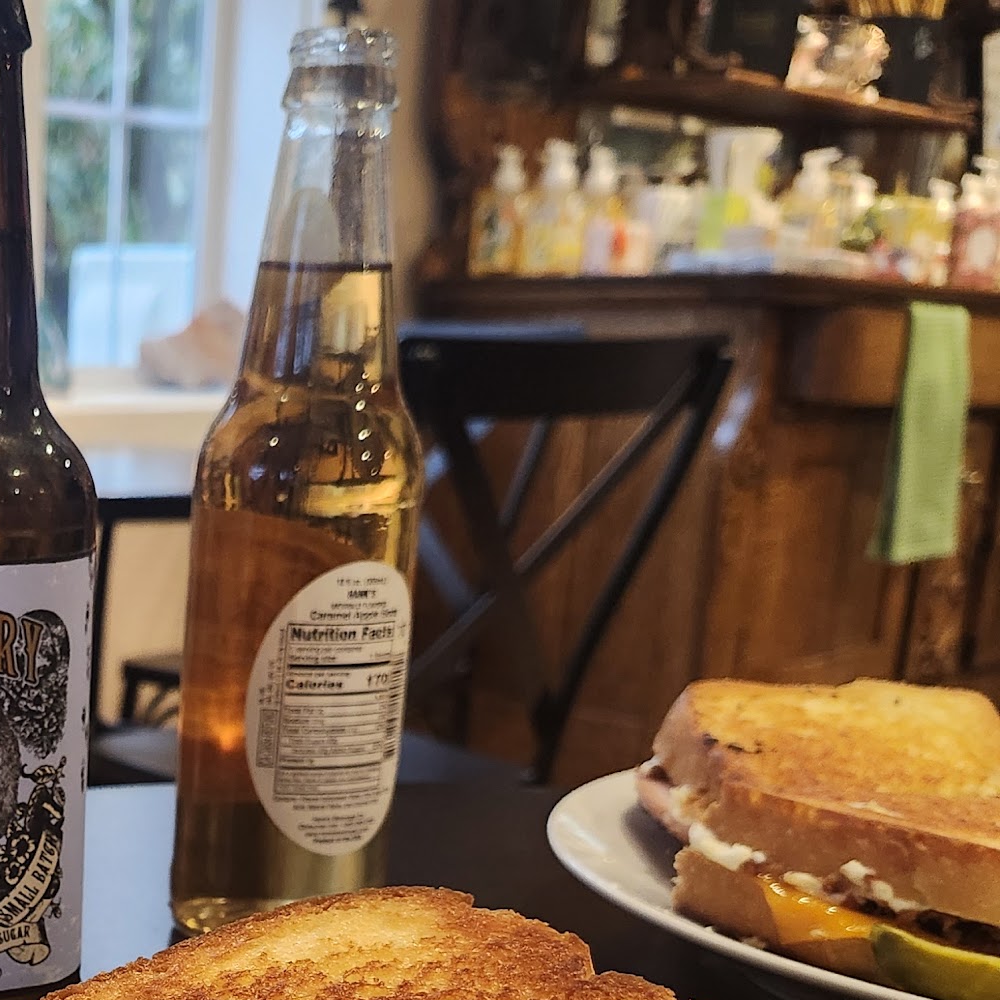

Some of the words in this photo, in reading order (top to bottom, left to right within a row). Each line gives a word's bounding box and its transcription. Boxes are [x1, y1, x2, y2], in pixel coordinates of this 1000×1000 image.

[290, 627, 357, 642] Nutrition
[361, 626, 394, 641] Facts
[286, 679, 343, 690] Calories
[31, 833, 60, 884] BATCH
